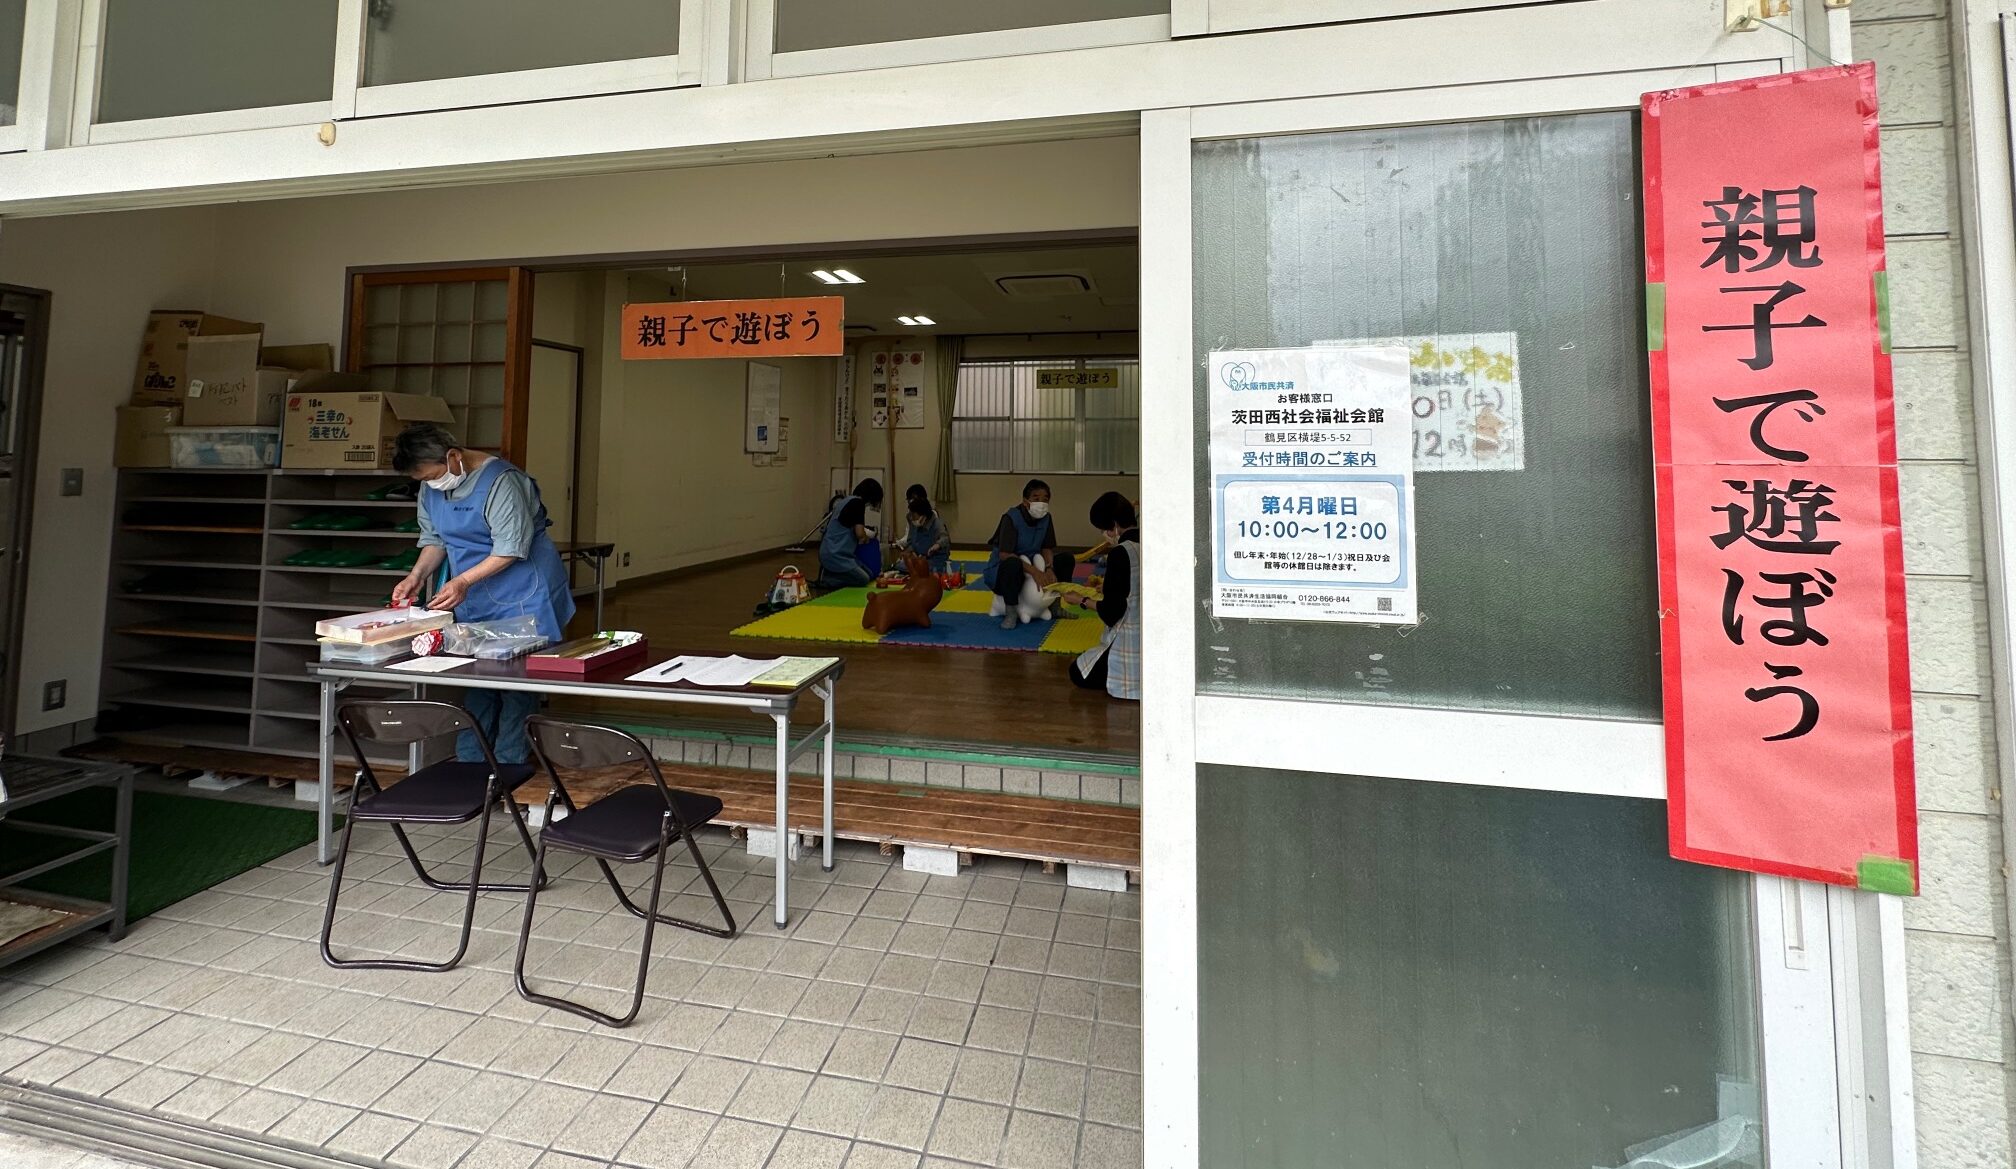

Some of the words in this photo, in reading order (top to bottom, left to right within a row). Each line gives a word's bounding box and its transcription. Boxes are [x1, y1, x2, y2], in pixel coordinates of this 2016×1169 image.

[638, 310, 820, 347] 親子で遊ぼう
[1041, 372, 1110, 385] 親子で遊ぼう
[1241, 380, 1294, 391] 大阪市民共済
[1277, 393, 1333, 404] お客様窓口
[316, 410, 345, 422] 三幸の
[1231, 408, 1384, 425] 茨田西社会福祉会館
[310, 426, 350, 439] 海老せん
[1264, 432, 1351, 443] 鶴見区横堤5-5-52
[1242, 450, 1376, 466] 受付時間のご案内
[1700, 185, 1841, 742] 親子で遊ぼう
[1261, 495, 1357, 516] 第4月曜日
[1264, 562, 1357, 572] 館等の休館日は除きます。
